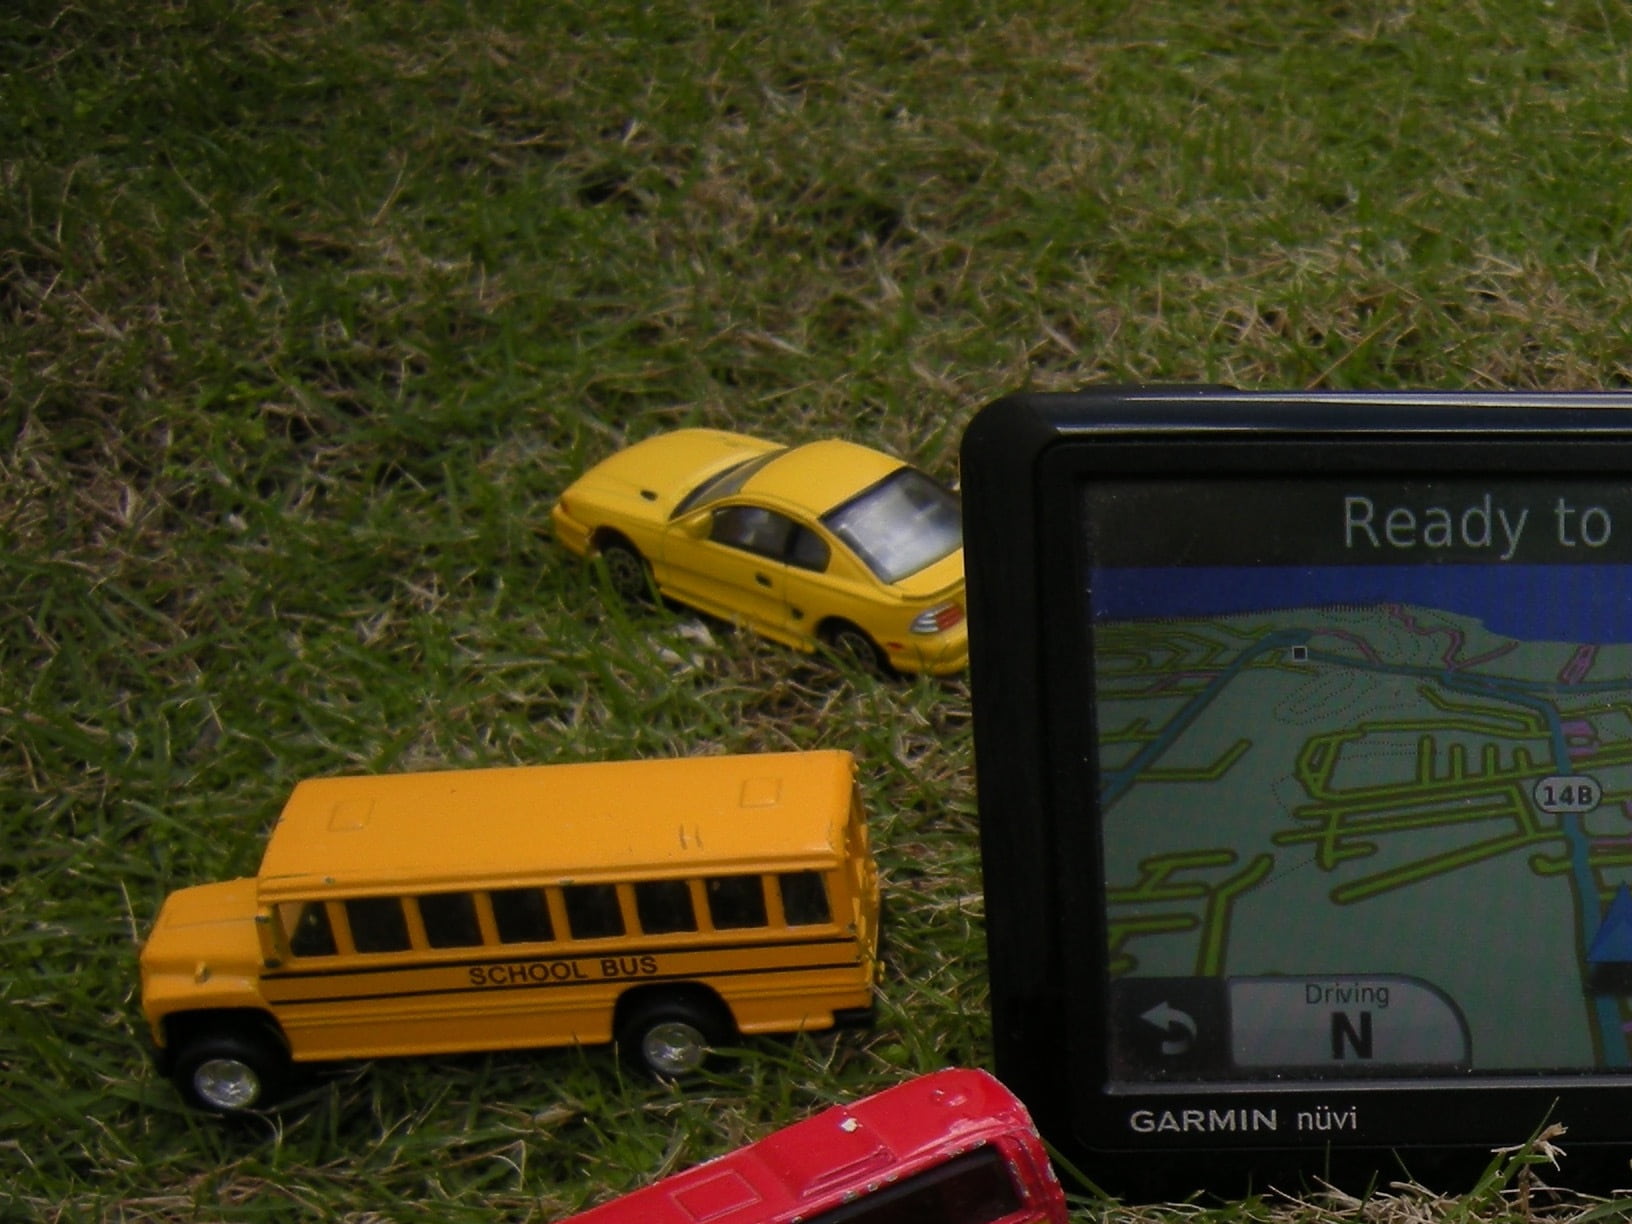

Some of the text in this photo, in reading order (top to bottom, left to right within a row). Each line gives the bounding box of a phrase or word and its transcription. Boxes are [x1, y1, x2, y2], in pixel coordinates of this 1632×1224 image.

[1344, 494, 1529, 561] Ready
[1554, 497, 1612, 548] to
[1542, 785, 1593, 807] 14B
[468, 956, 659, 986] SCHOOL BUS
[1305, 982, 1390, 1009] Driving
[1330, 1010, 1374, 1060] N
[1129, 1106, 1358, 1133] GARMIN nüvi
